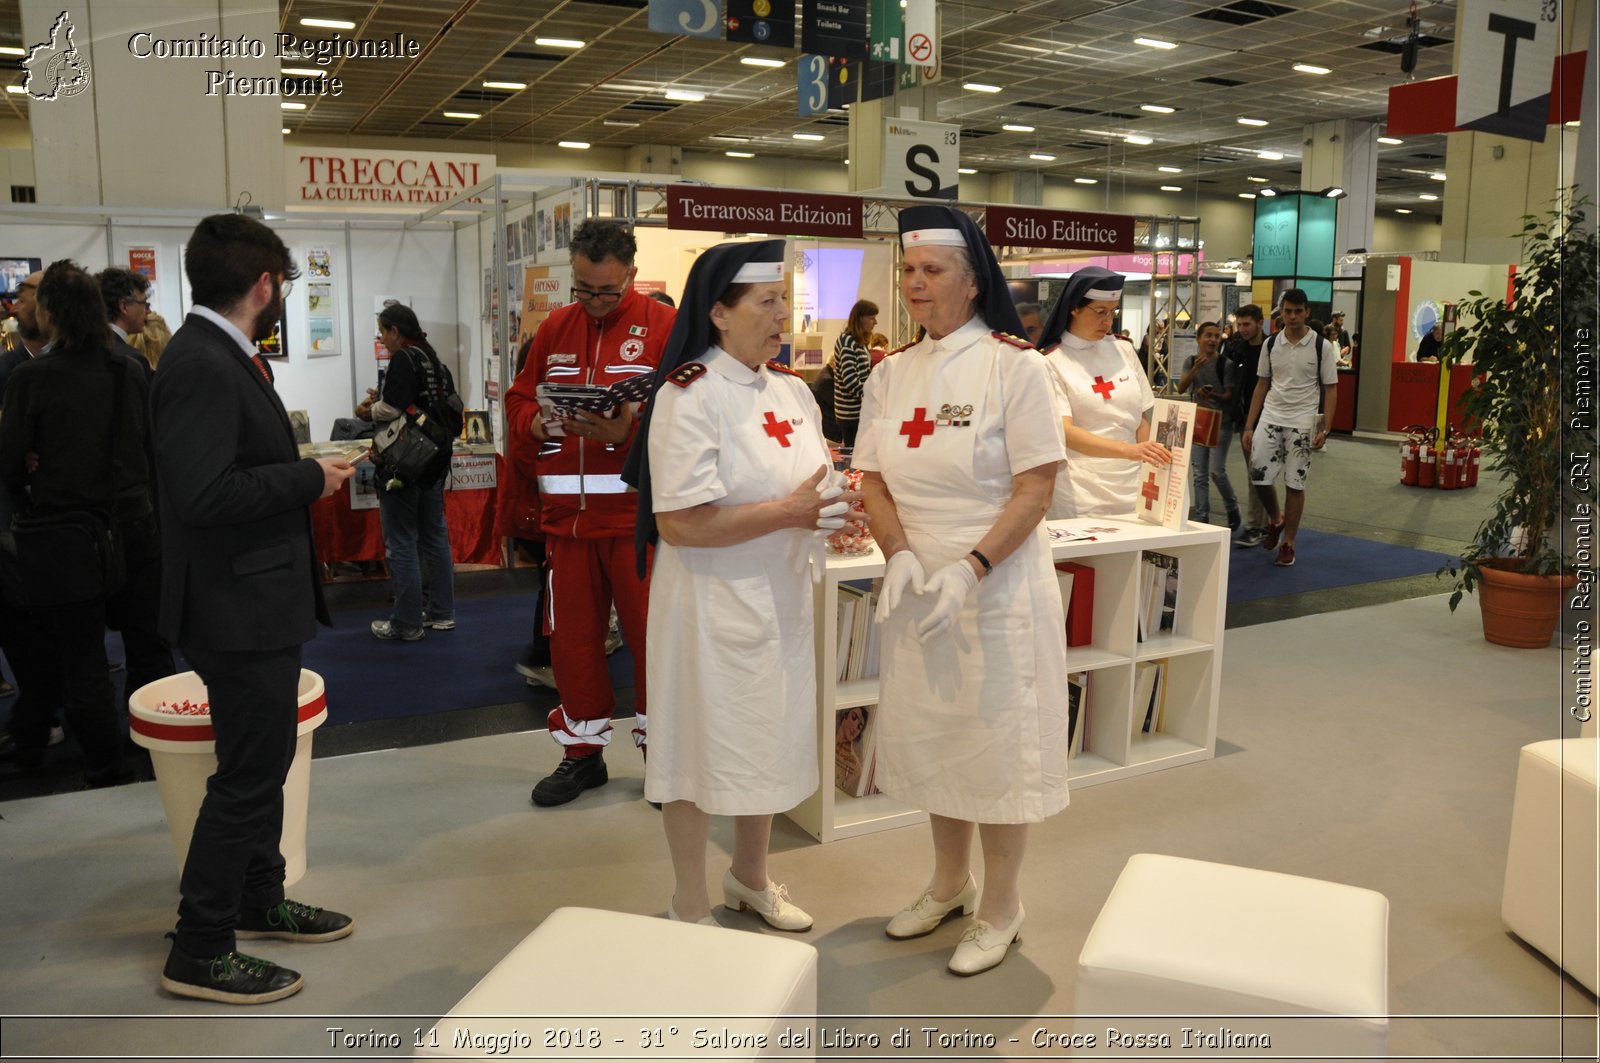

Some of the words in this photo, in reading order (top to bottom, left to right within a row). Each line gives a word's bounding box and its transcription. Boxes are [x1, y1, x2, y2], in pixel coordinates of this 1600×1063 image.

[816, 2, 837, 12] Snack
[758, 21, 767, 37] 5
[1488, 13, 1536, 117] T
[808, 55, 827, 111] 3
[949, 132, 957, 146] 3
[300, 156, 481, 189] TRECCANI
[904, 143, 941, 198] S
[301, 187, 324, 201] LA
[326, 188, 404, 202] CULTURA
[408, 191, 483, 205] ITALI
[679, 198, 775, 222] Terrarossa
[780, 203, 852, 226] Edizioni
[1005, 216, 1047, 241] Stilo
[1052, 220, 1118, 244] Editrice
